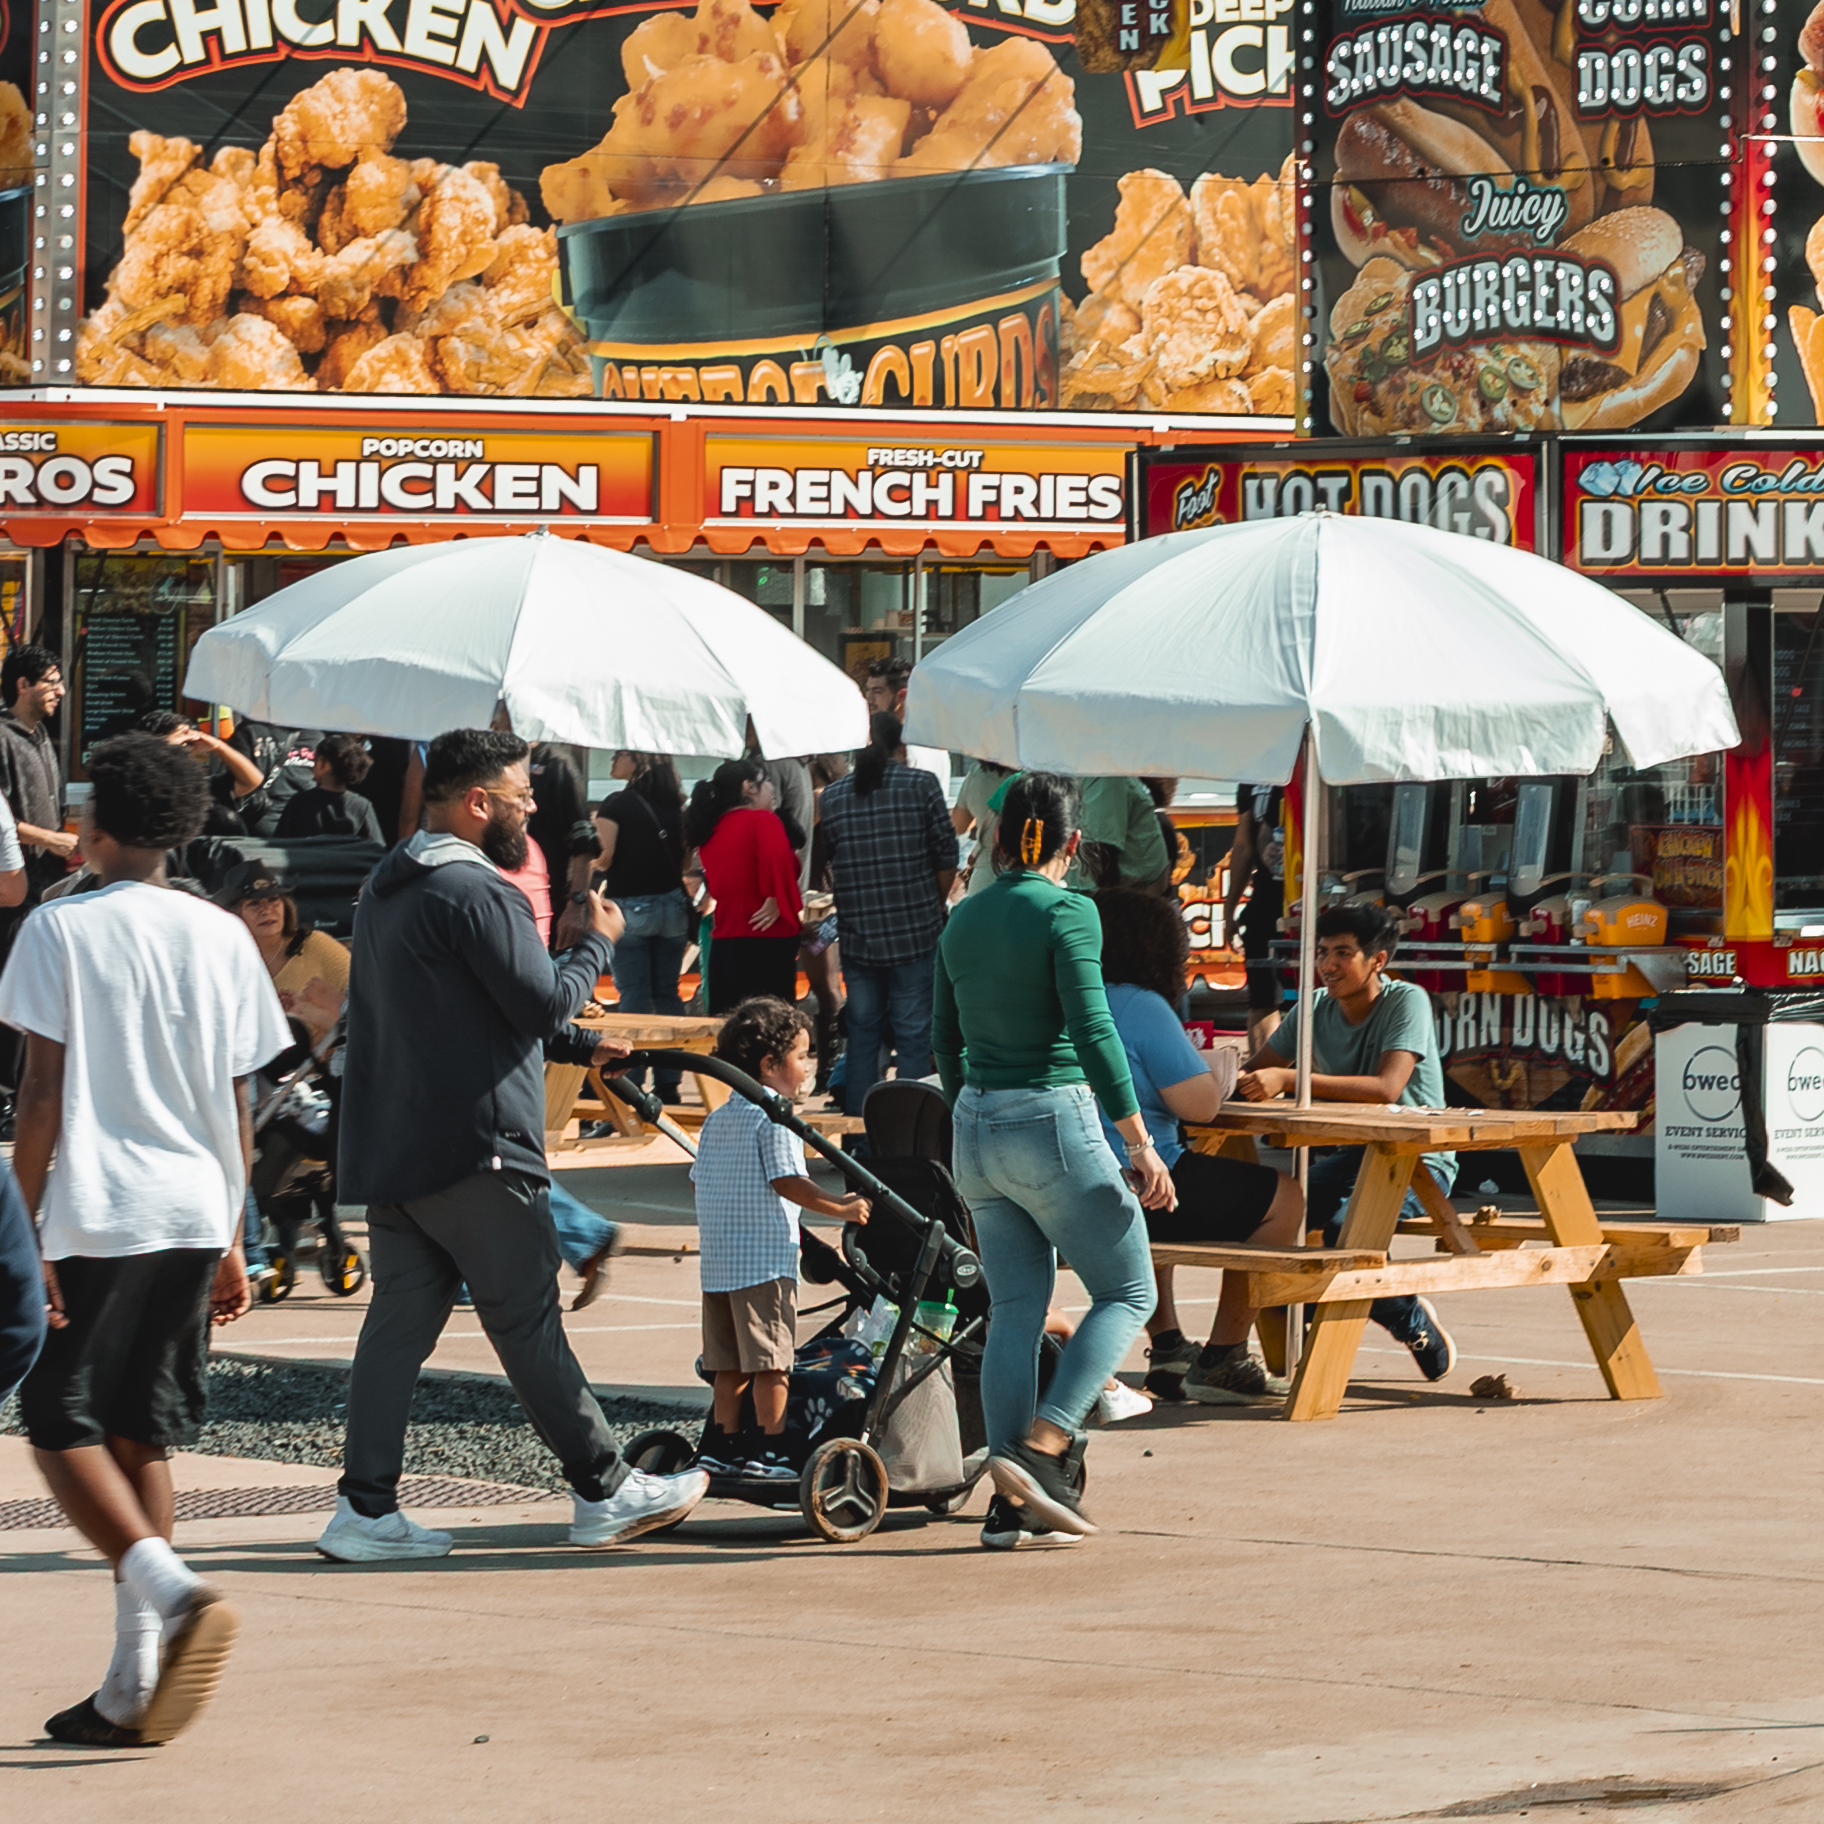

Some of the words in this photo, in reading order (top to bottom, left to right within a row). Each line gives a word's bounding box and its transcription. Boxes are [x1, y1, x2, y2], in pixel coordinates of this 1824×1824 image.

[1328, 21, 1501, 108] SAUSAGE
[1579, 46, 1708, 108] DOGS
[1463, 181, 1566, 240] Juicy
[1413, 260, 1618, 356] BURGERS
[363, 439, 484, 459] POPCORN
[867, 449, 983, 468] FRESH-CUT
[241, 462, 598, 511] CHICKEN
[721, 469, 955, 519] FRENCH
[967, 474, 1123, 521] FRIES
[1177, 472, 1218, 525] Foot
[1633, 461, 1712, 494] Ice
[1362, 470, 1510, 544] DOGS
[1627, 913, 1658, 928] HEINZ
[1688, 951, 1736, 975] SAGE
[1665, 1126, 1704, 1137] EVENT
